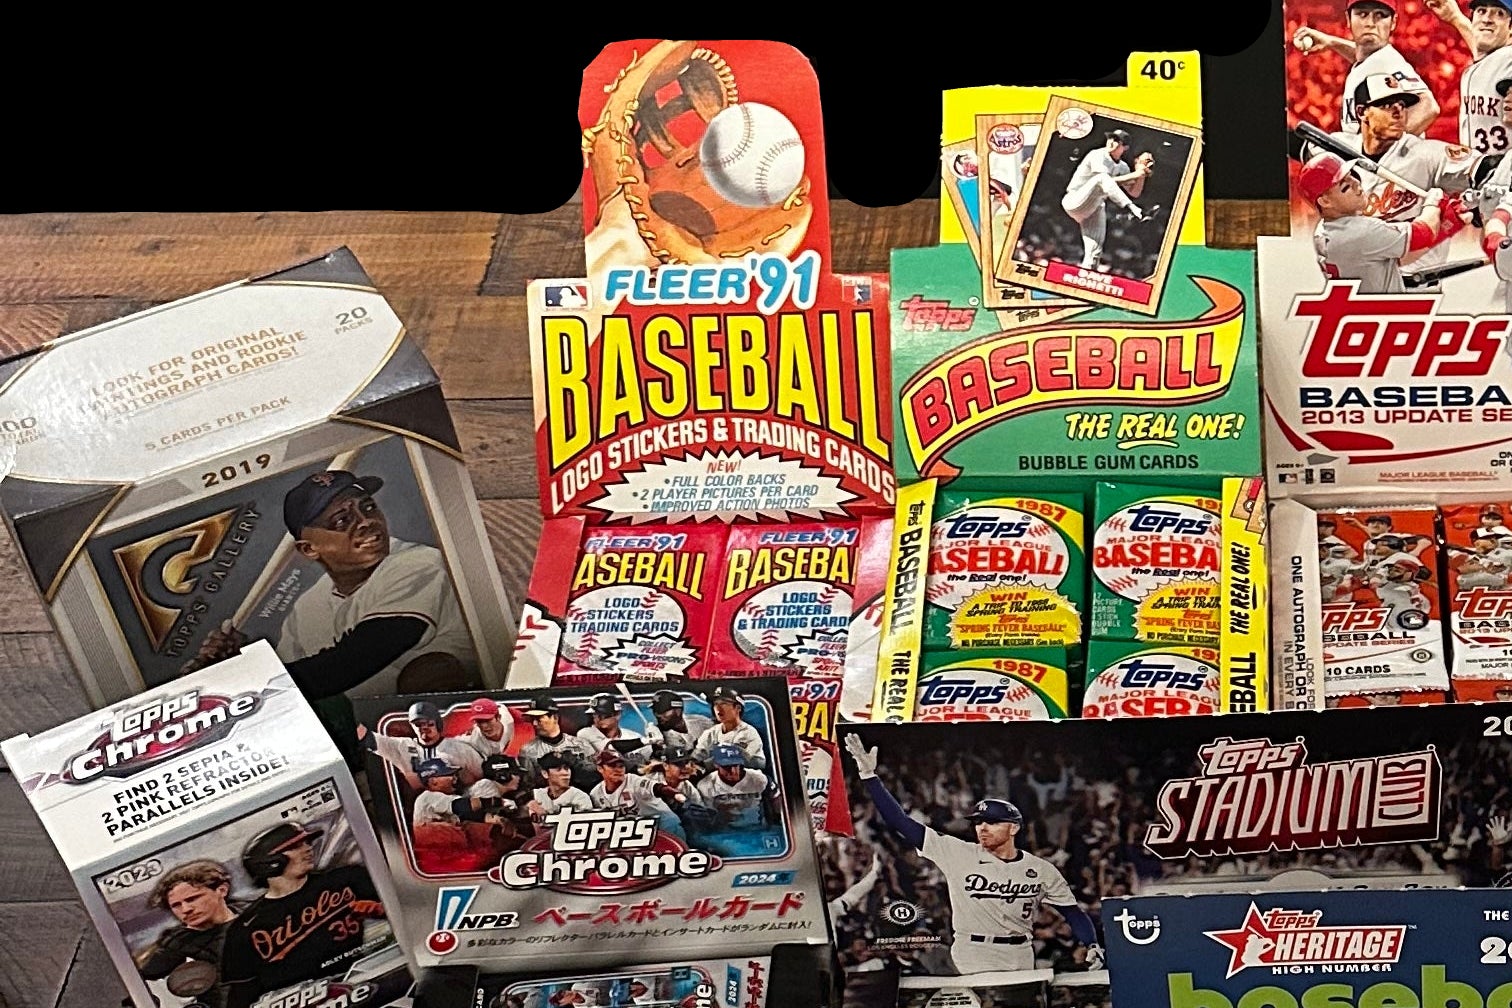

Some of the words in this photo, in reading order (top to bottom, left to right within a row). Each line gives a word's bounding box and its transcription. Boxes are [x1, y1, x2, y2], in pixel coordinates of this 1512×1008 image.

[335, 306, 368, 325] 20
[191, 355, 231, 375] AND
[239, 331, 307, 359] ROOKIE
[543, 310, 891, 470] BASEBALL
[911, 334, 1222, 451] BASEBALL
[1066, 413, 1111, 440] THE
[1117, 413, 1181, 440] REAL
[1185, 413, 1246, 440] ONE!
[1301, 409, 1366, 425] 2013
[1374, 408, 1468, 424] UPDATE
[202, 453, 271, 488] 2019
[551, 452, 603, 515] LOGO
[608, 419, 708, 470] STICKERS
[713, 421, 728, 441] &
[734, 418, 821, 459] TRADING
[825, 439, 895, 505] CARDS
[1019, 456, 1088, 471] BUBBLE
[1094, 456, 1136, 470] GUM
[1140, 455, 1199, 470] CARDS
[642, 489, 649, 501] 2
[652, 489, 697, 500] PLAYER
[701, 487, 757, 499] PICTURES
[760, 487, 783, 498] PER
[785, 485, 818, 497] CARD
[1015, 499, 1068, 523] 1987
[205, 509, 261, 593] GALLERY
[990, 592, 1029, 602] WIN
[70, 692, 257, 784] Chrome
[101, 811, 114, 824] 2
[117, 790, 167, 818] PINK
[169, 746, 276, 794] REFRACTOR
[112, 779, 160, 805] FIND
[162, 773, 174, 786] 2
[178, 750, 236, 780] SEPIA
[106, 784, 217, 837] PARALLELS
[219, 756, 290, 788] INSIDE!
[1147, 758, 1369, 847] STADIUM
[501, 850, 709, 888] Chrome
[458, 914, 514, 929] NPB
[533, 891, 806, 925] ベースボールカード
[1483, 910, 1510, 921] THE
[1274, 929, 1400, 961] HERITAGE
[1272, 965, 1317, 976] HIGH
[1321, 963, 1392, 975] NUMBER
